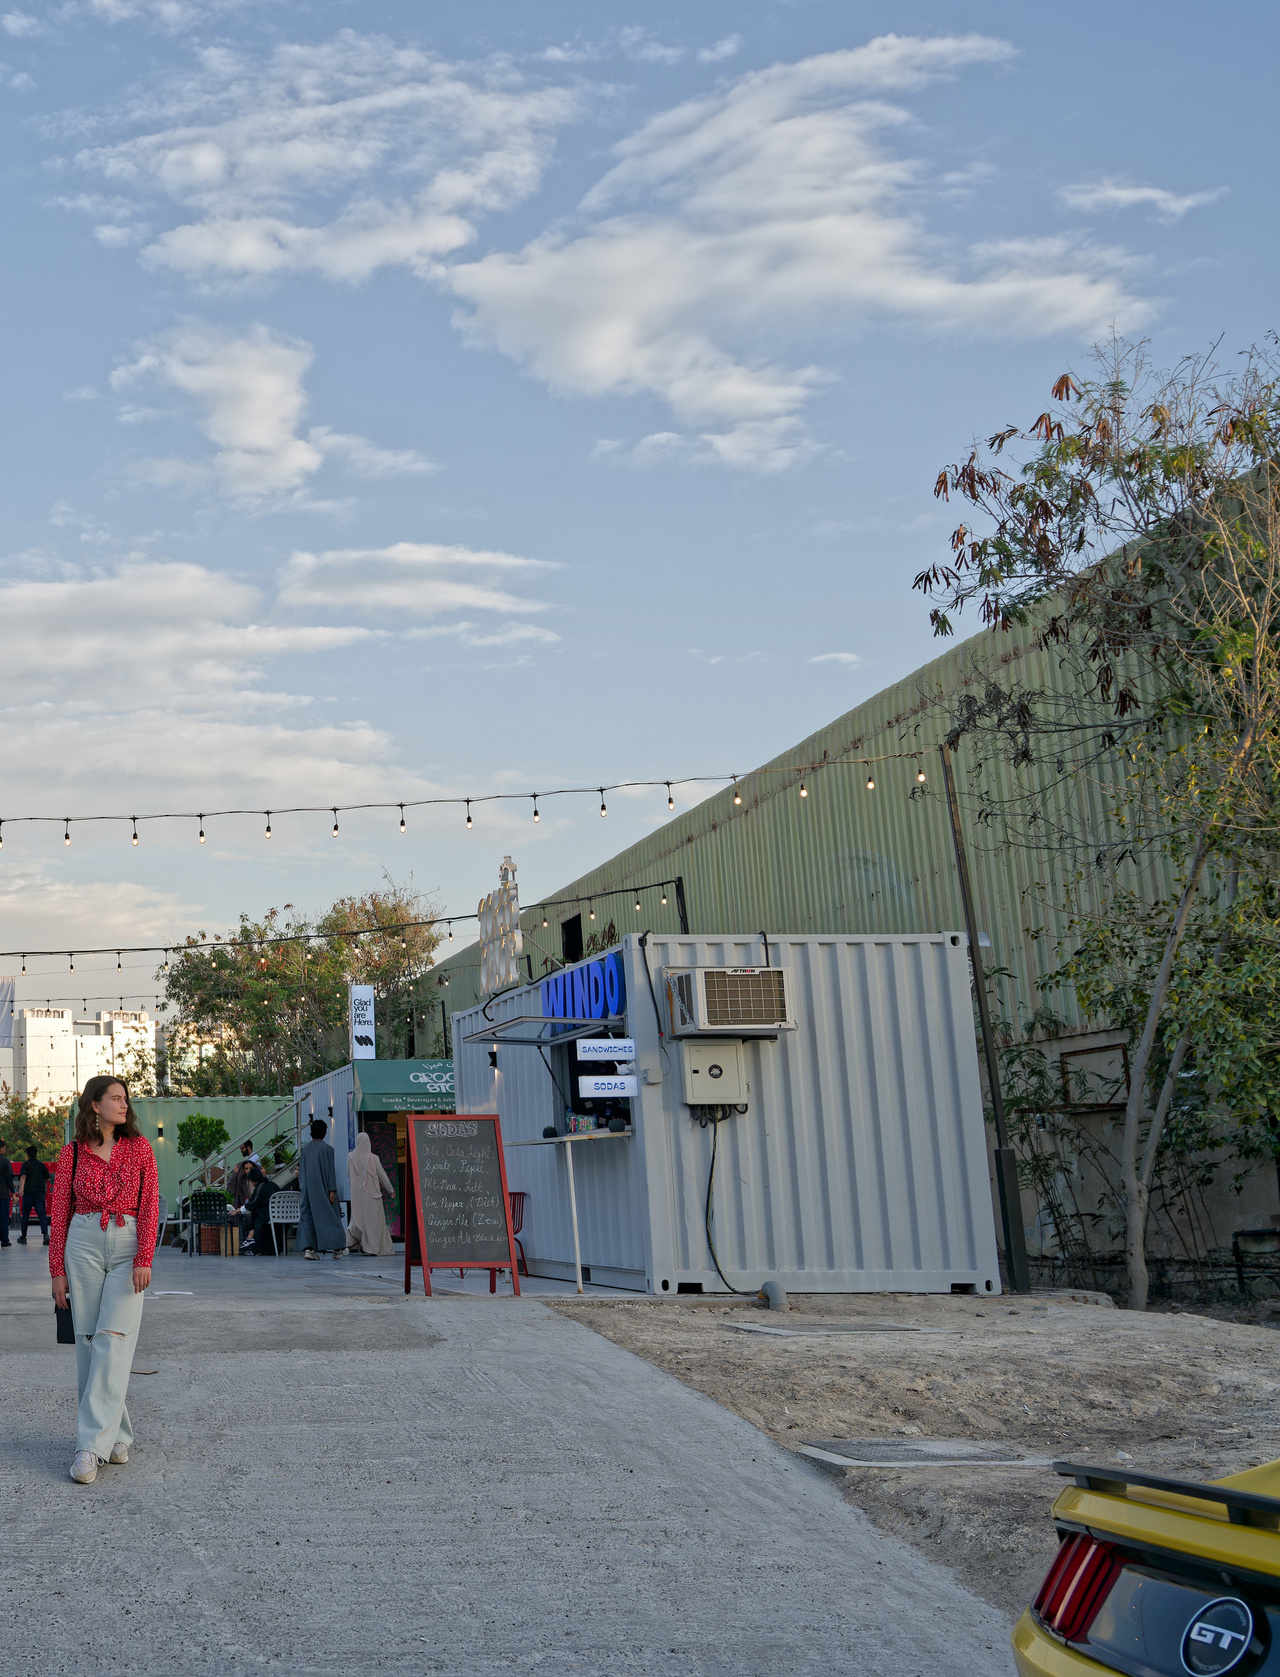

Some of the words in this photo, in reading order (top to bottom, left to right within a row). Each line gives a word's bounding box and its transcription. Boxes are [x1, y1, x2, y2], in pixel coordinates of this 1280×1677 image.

[541, 953, 626, 1033] WINDO
[353, 998, 371, 1006] Glad
[353, 1018, 374, 1026] Here.
[581, 1045, 634, 1054] SANDWICHES
[593, 1082, 626, 1091] SODAS
[425, 1121, 479, 1138] SODAS
[446, 1144, 465, 1158] Cola
[428, 1213, 453, 1231] Ginger
[429, 1231, 456, 1248] Ginger
[1190, 1622, 1246, 1650] GT
